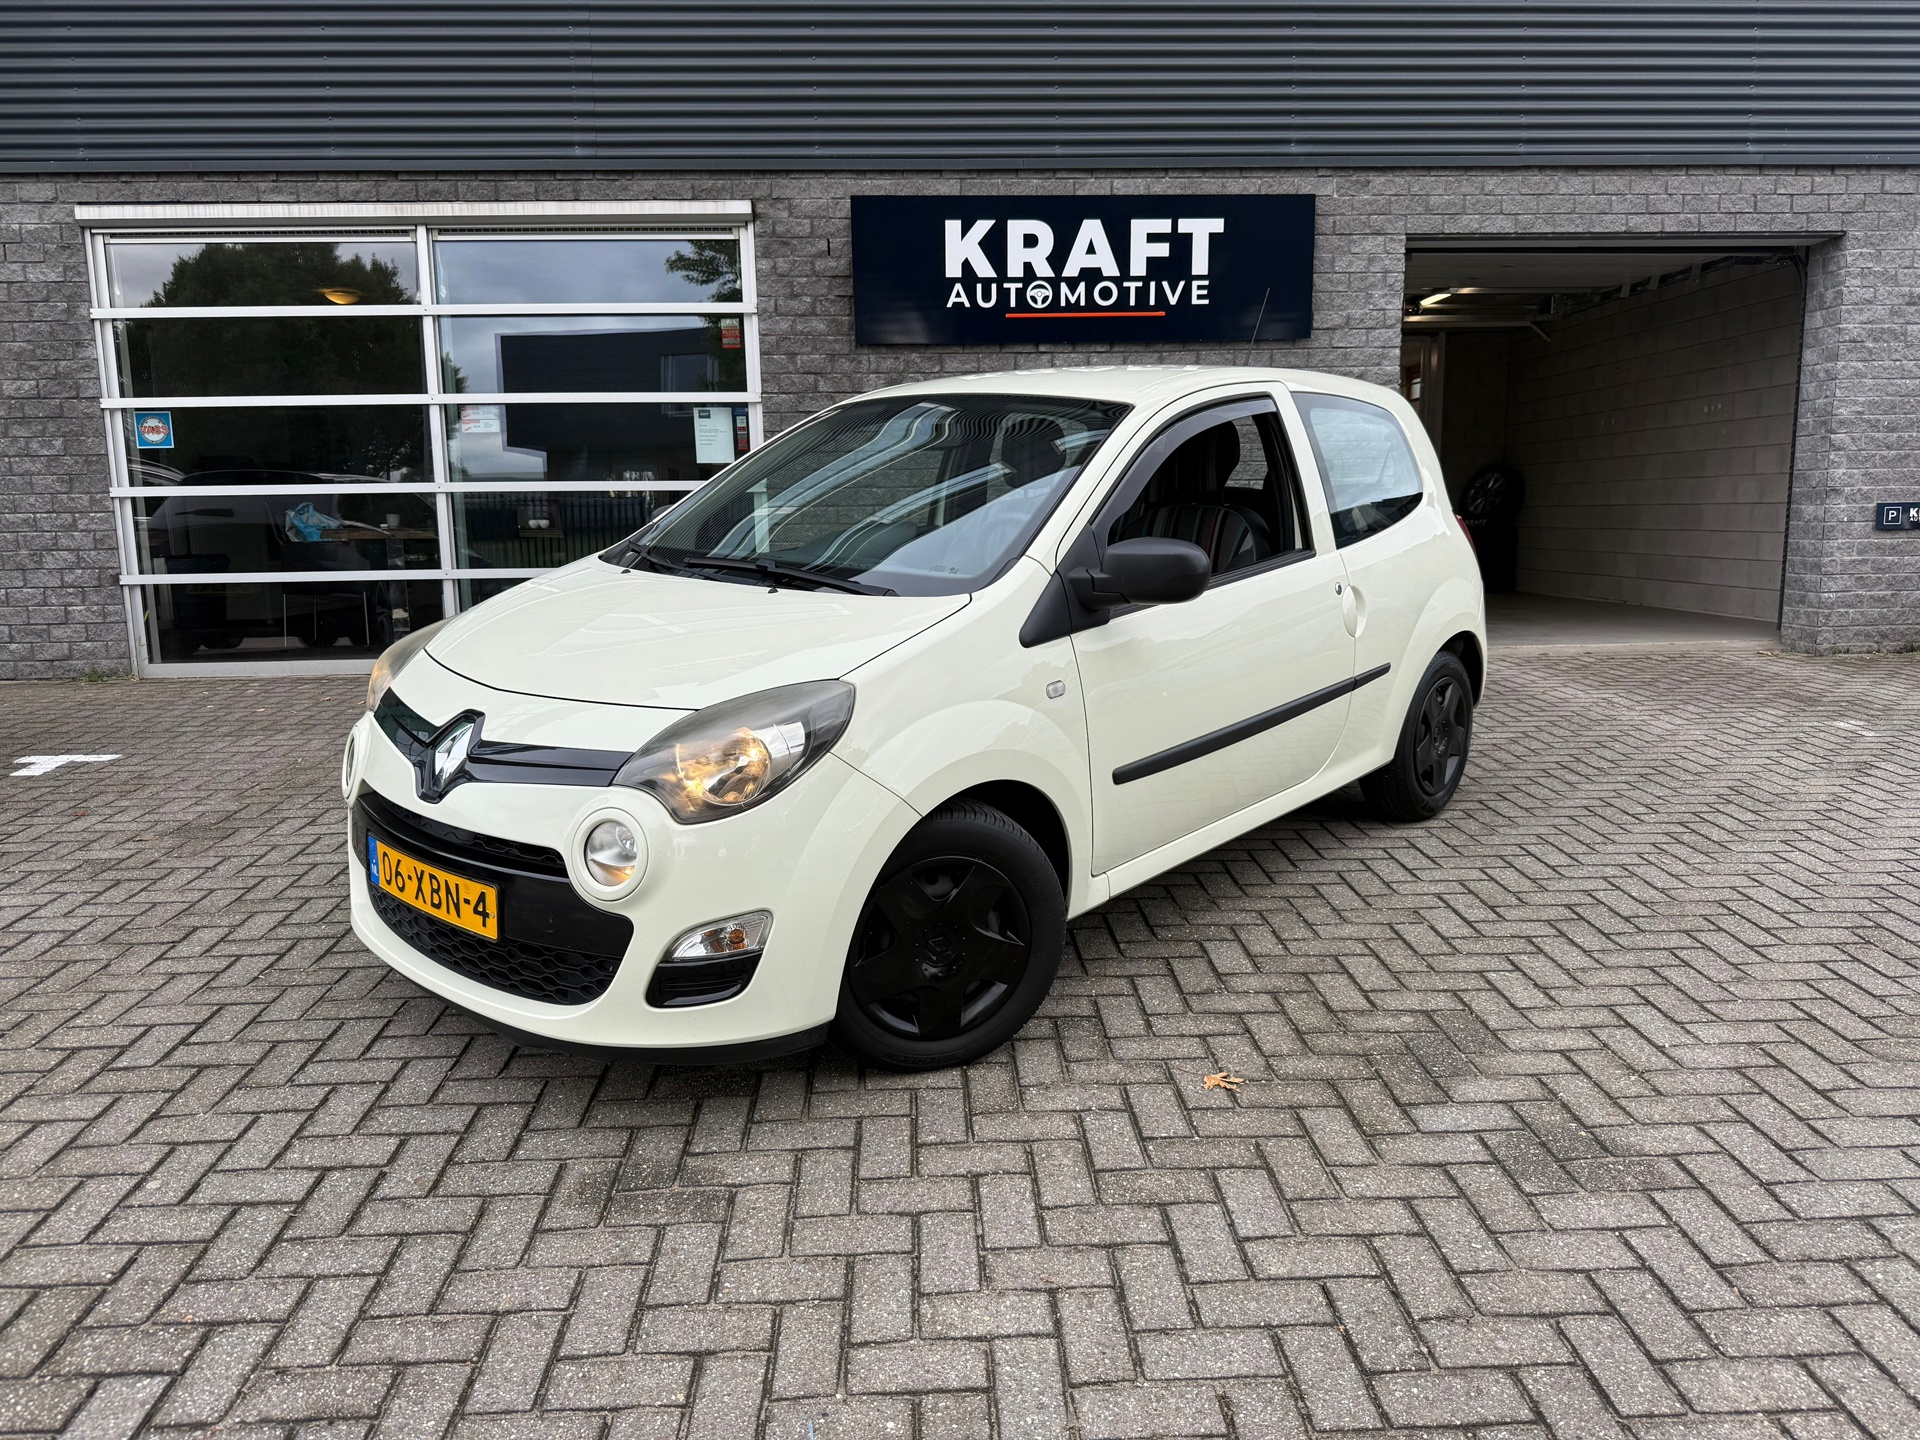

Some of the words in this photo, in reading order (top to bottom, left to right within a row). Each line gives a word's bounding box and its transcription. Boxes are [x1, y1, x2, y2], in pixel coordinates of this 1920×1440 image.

[945, 218, 1225, 278] KRAFT
[946, 280, 1210, 308] AUTOMOTIVE
[1888, 511, 1897, 520] P
[1910, 508, 1920, 517] K
[382, 851, 490, 929] 06-XBN-4
